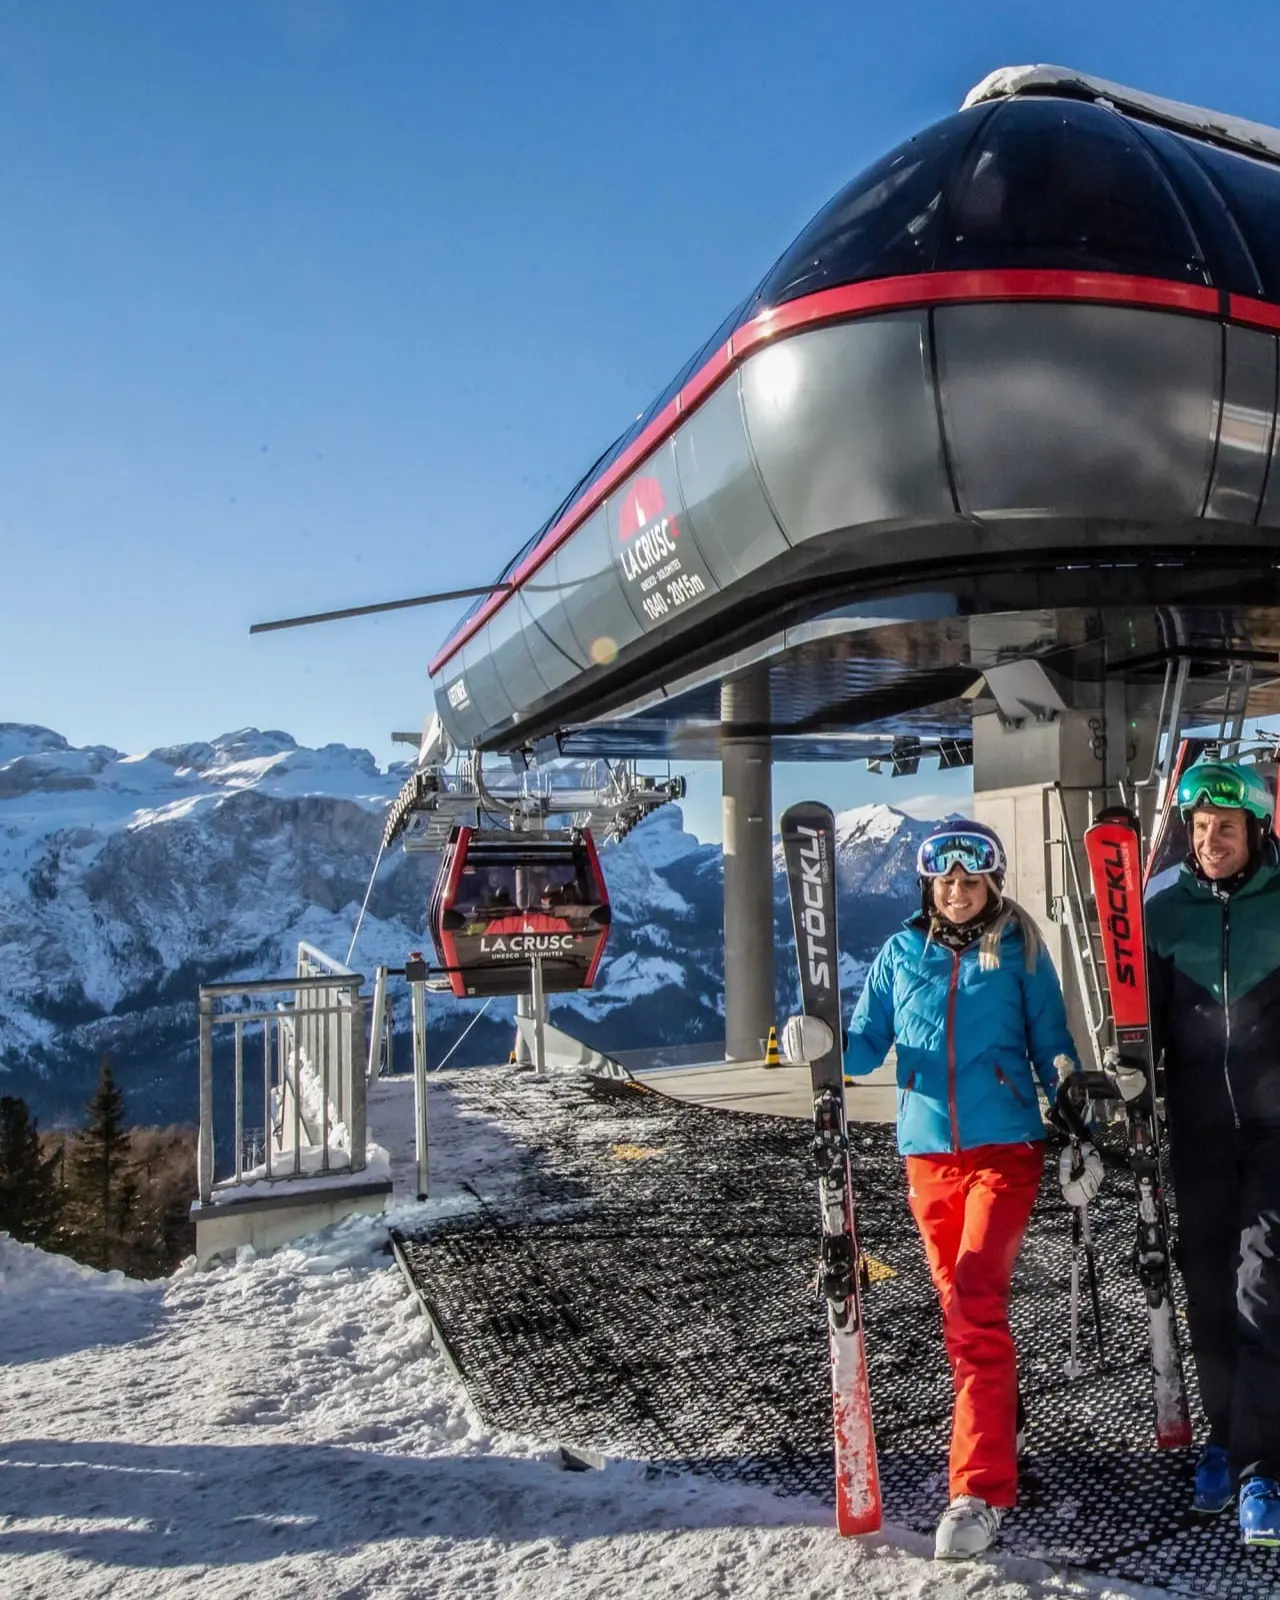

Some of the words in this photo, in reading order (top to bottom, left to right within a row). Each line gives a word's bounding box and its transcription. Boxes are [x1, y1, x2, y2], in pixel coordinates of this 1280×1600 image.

[643, 592, 668, 620] 1840
[667, 574, 706, 606] 2015m
[797, 826, 830, 989] STÖCKLI
[1102, 839, 1136, 987] STÖCKLI
[480, 937, 506, 952] LA
[491, 952, 519, 960] UNESCO
